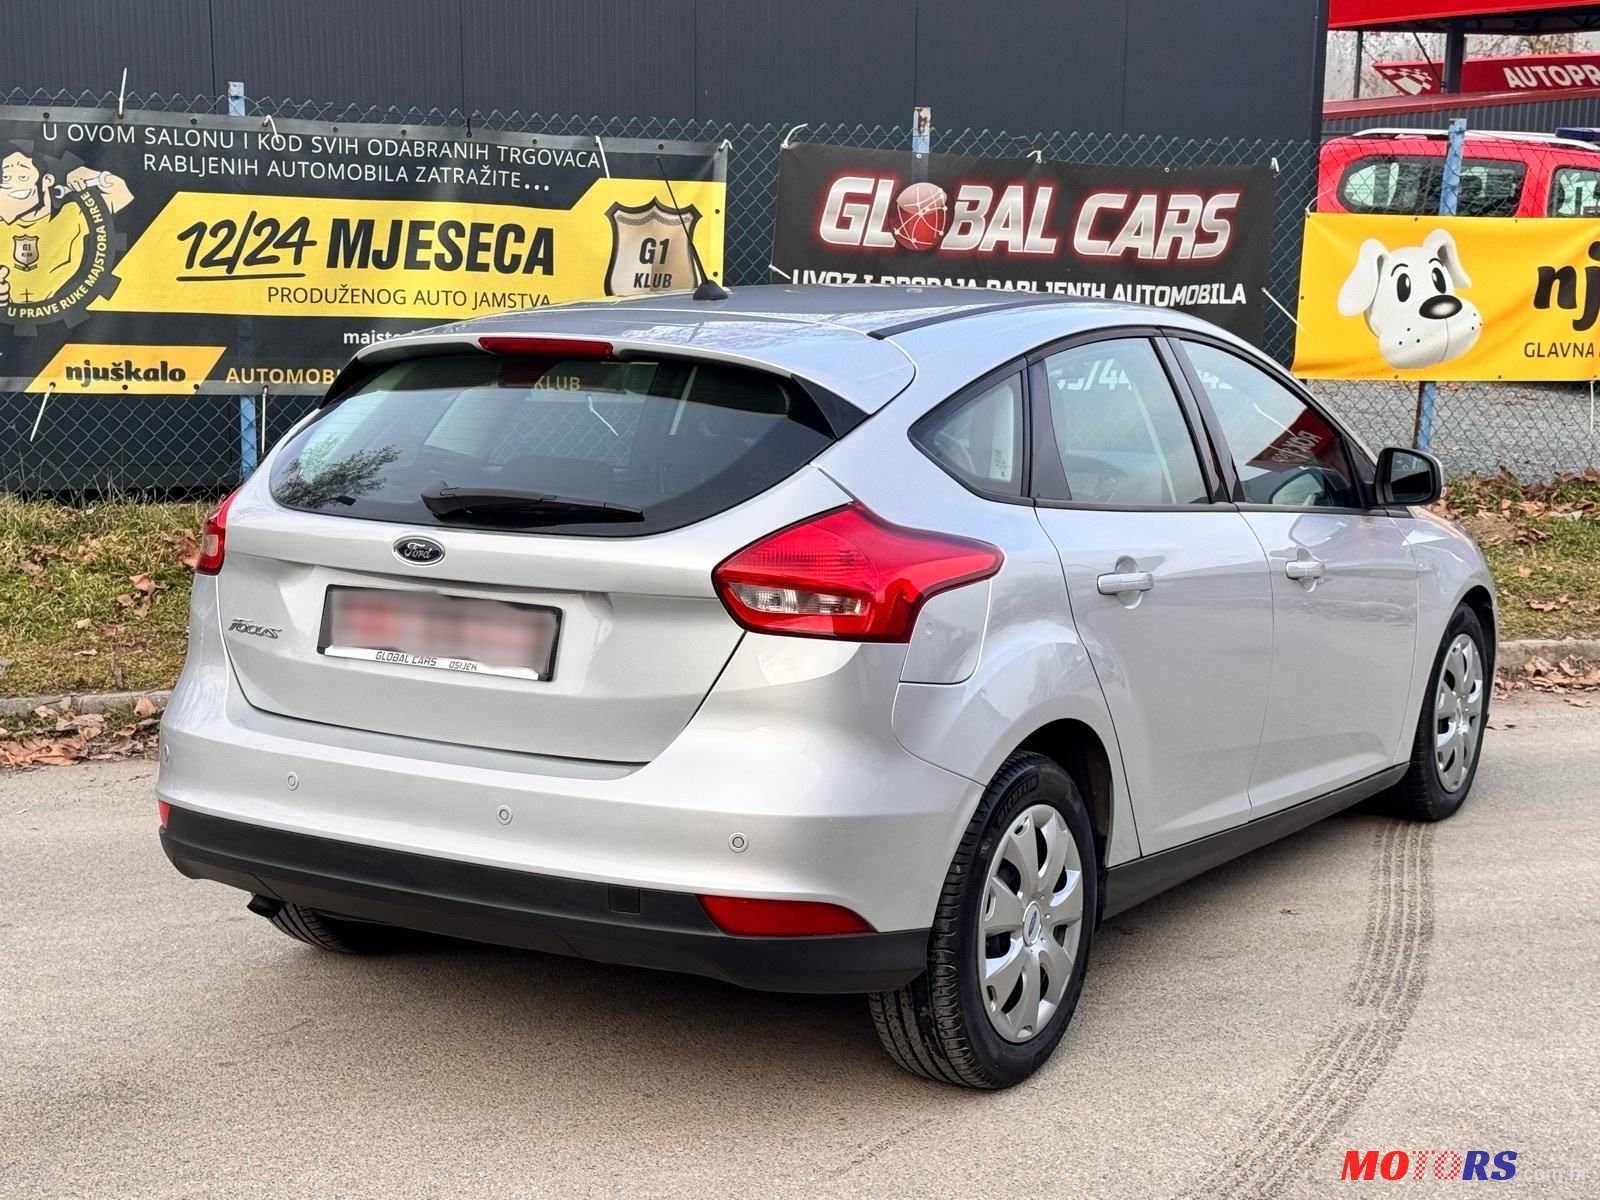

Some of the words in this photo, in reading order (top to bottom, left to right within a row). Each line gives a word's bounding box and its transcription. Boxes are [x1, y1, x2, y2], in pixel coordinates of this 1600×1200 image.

[42, 124, 57, 141] U
[67, 124, 135, 144] OVOM
[145, 127, 234, 150] SALONU
[244, 132, 249, 150] I
[258, 133, 303, 152] KOD
[311, 136, 358, 155] SVIH
[368, 139, 489, 161] ODABRANIH
[497, 146, 601, 169] TRGOVACA
[144, 154, 258, 178] RABLJENIH
[267, 160, 409, 183] AUTOMOBILA
[80, 191, 104, 223] HRGE
[818, 176, 1058, 254] GLOBAL
[1073, 192, 1241, 259] CARS
[85, 225, 107, 288] MAJSTORA
[177, 210, 317, 275] 12/24
[326, 218, 554, 276] MJESECA
[638, 238, 670, 265] G1
[633, 273, 672, 289] KLUB
[1533, 241, 1600, 331] nj
[60, 287, 89, 310] RUKE
[267, 283, 407, 305] PRODUŽENOG
[413, 288, 468, 308] AUTO
[472, 290, 551, 310] JAMSTVA
[1112, 283, 1247, 307] AUTOMOBILA
[8, 308, 16, 317] U
[20, 303, 60, 318] PRAVE
[1524, 342, 1594, 358] GLAVNA
[65, 359, 187, 387] njuškalo
[404, 541, 433, 560] Ford
[375, 651, 409, 664] GLOBAL
[412, 655, 438, 667] CARS
